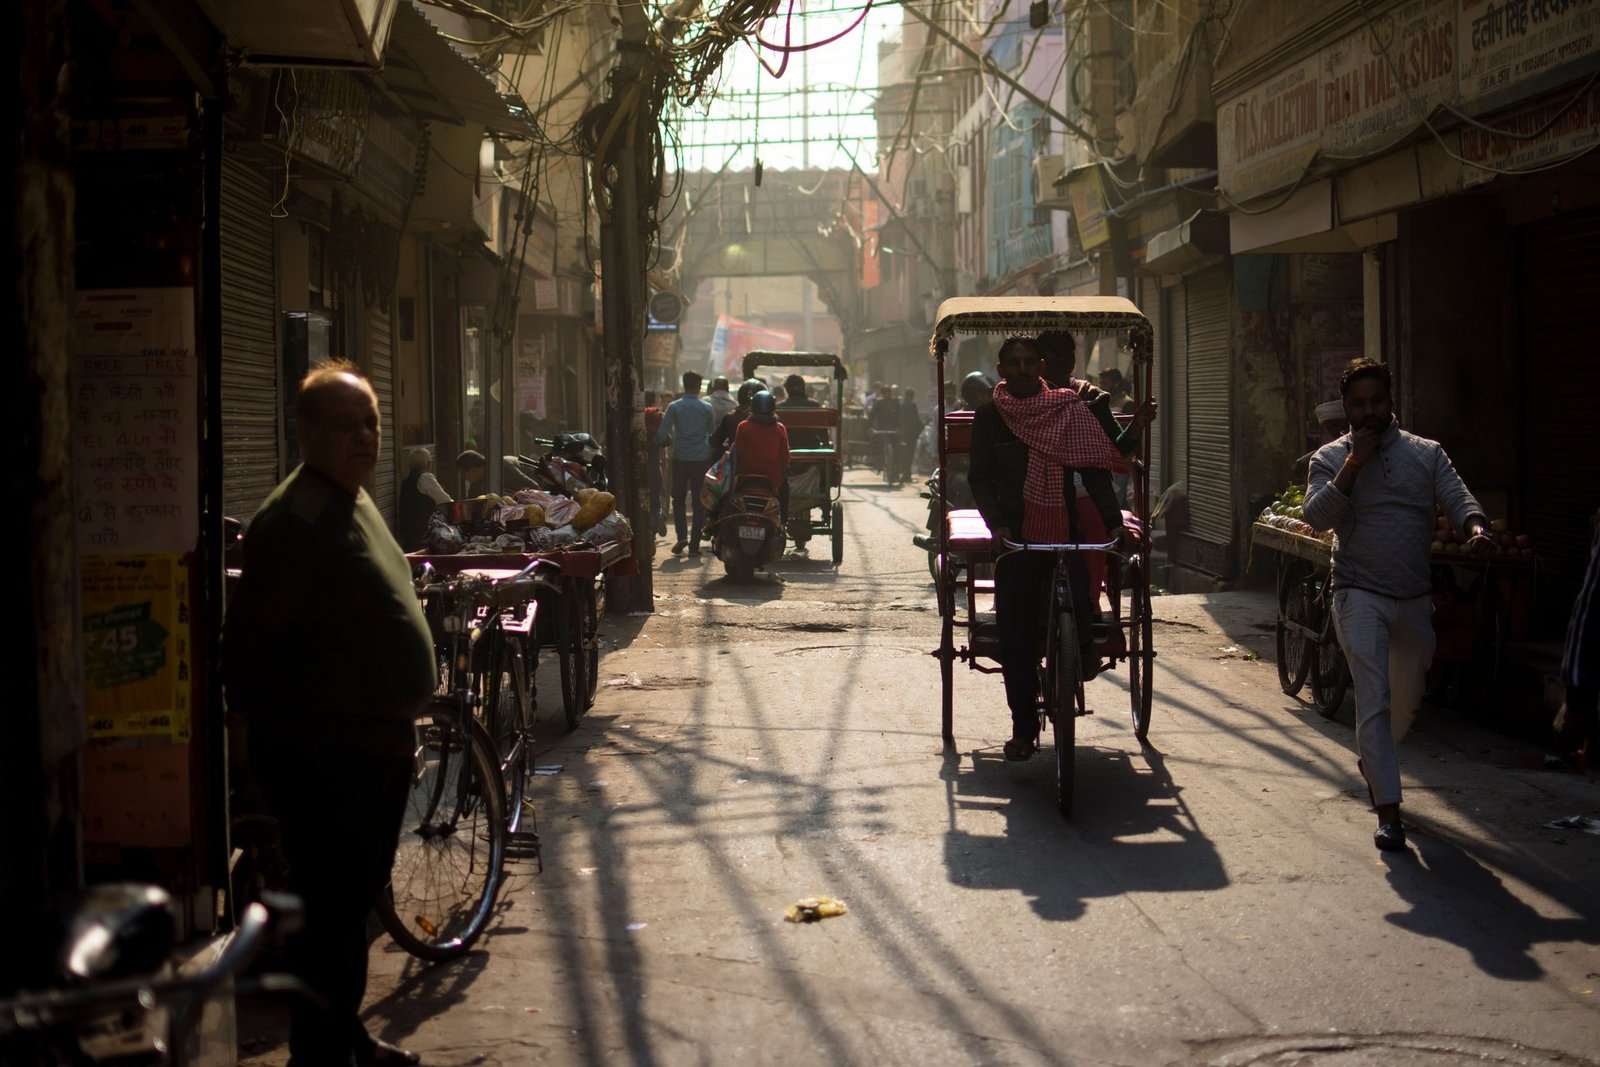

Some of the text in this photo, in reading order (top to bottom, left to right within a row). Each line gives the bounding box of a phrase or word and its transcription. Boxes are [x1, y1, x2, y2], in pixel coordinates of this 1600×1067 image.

[1472, 2, 1503, 51] दलीप
[1363, 56, 1396, 109] MAL
[1410, 21, 1453, 89] SONS
[84, 358, 186, 374] FREE FREE
[142, 348, 166, 357] TATA
